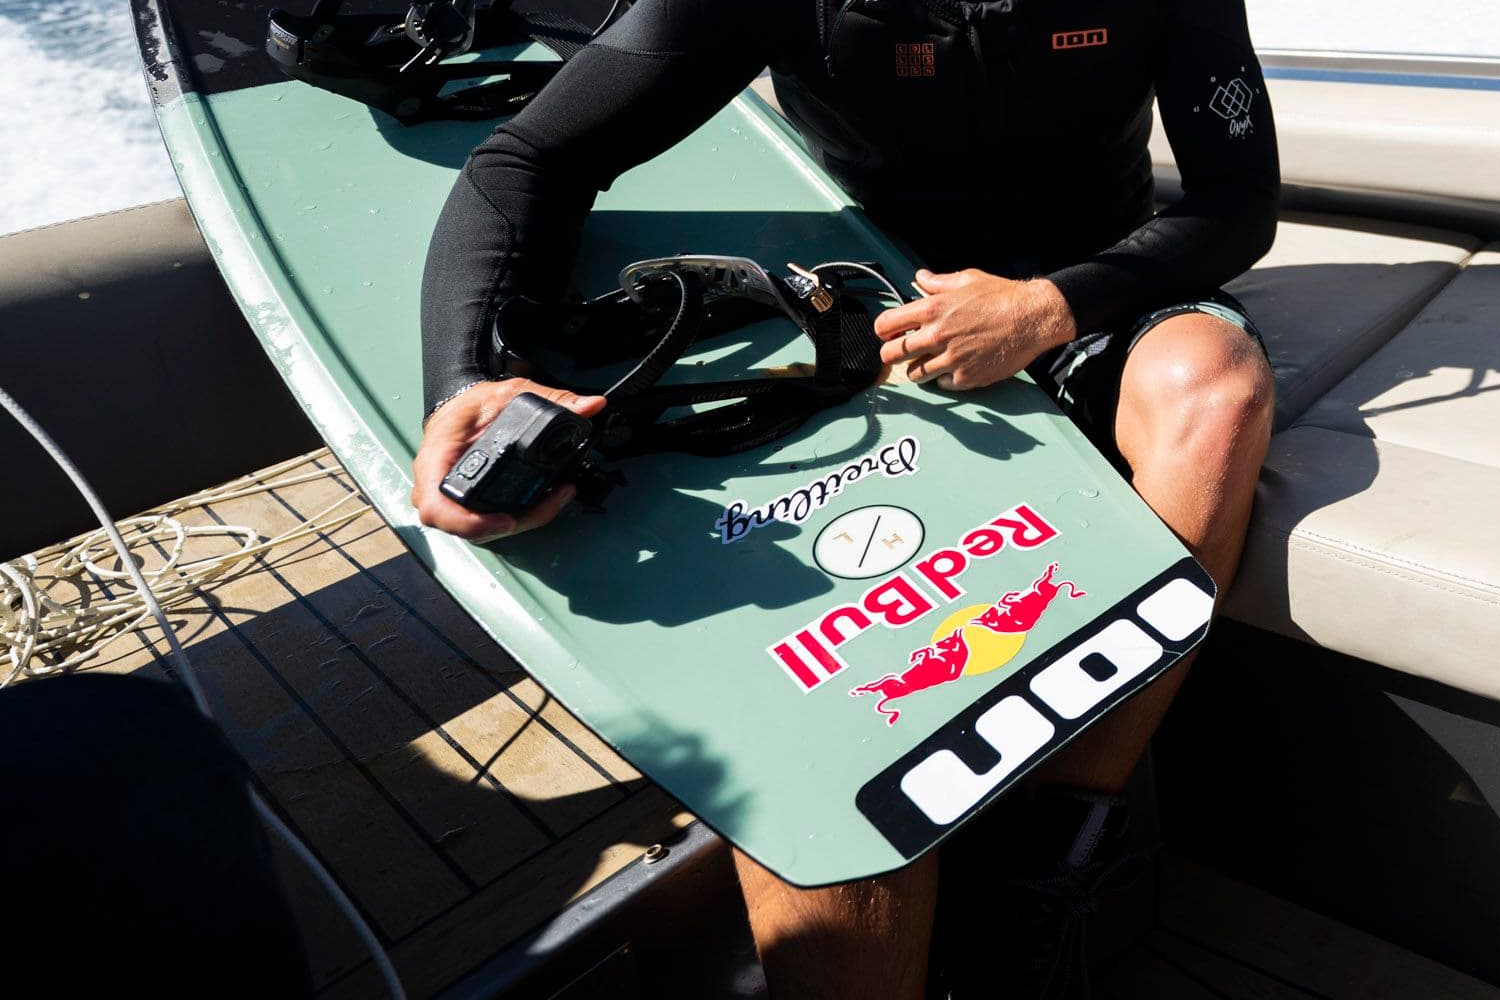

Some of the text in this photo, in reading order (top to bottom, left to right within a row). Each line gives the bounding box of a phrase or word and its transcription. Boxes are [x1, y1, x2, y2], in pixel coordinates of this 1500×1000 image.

[718, 436, 919, 542] Breitling
[770, 504, 1060, 692] Red Bull
